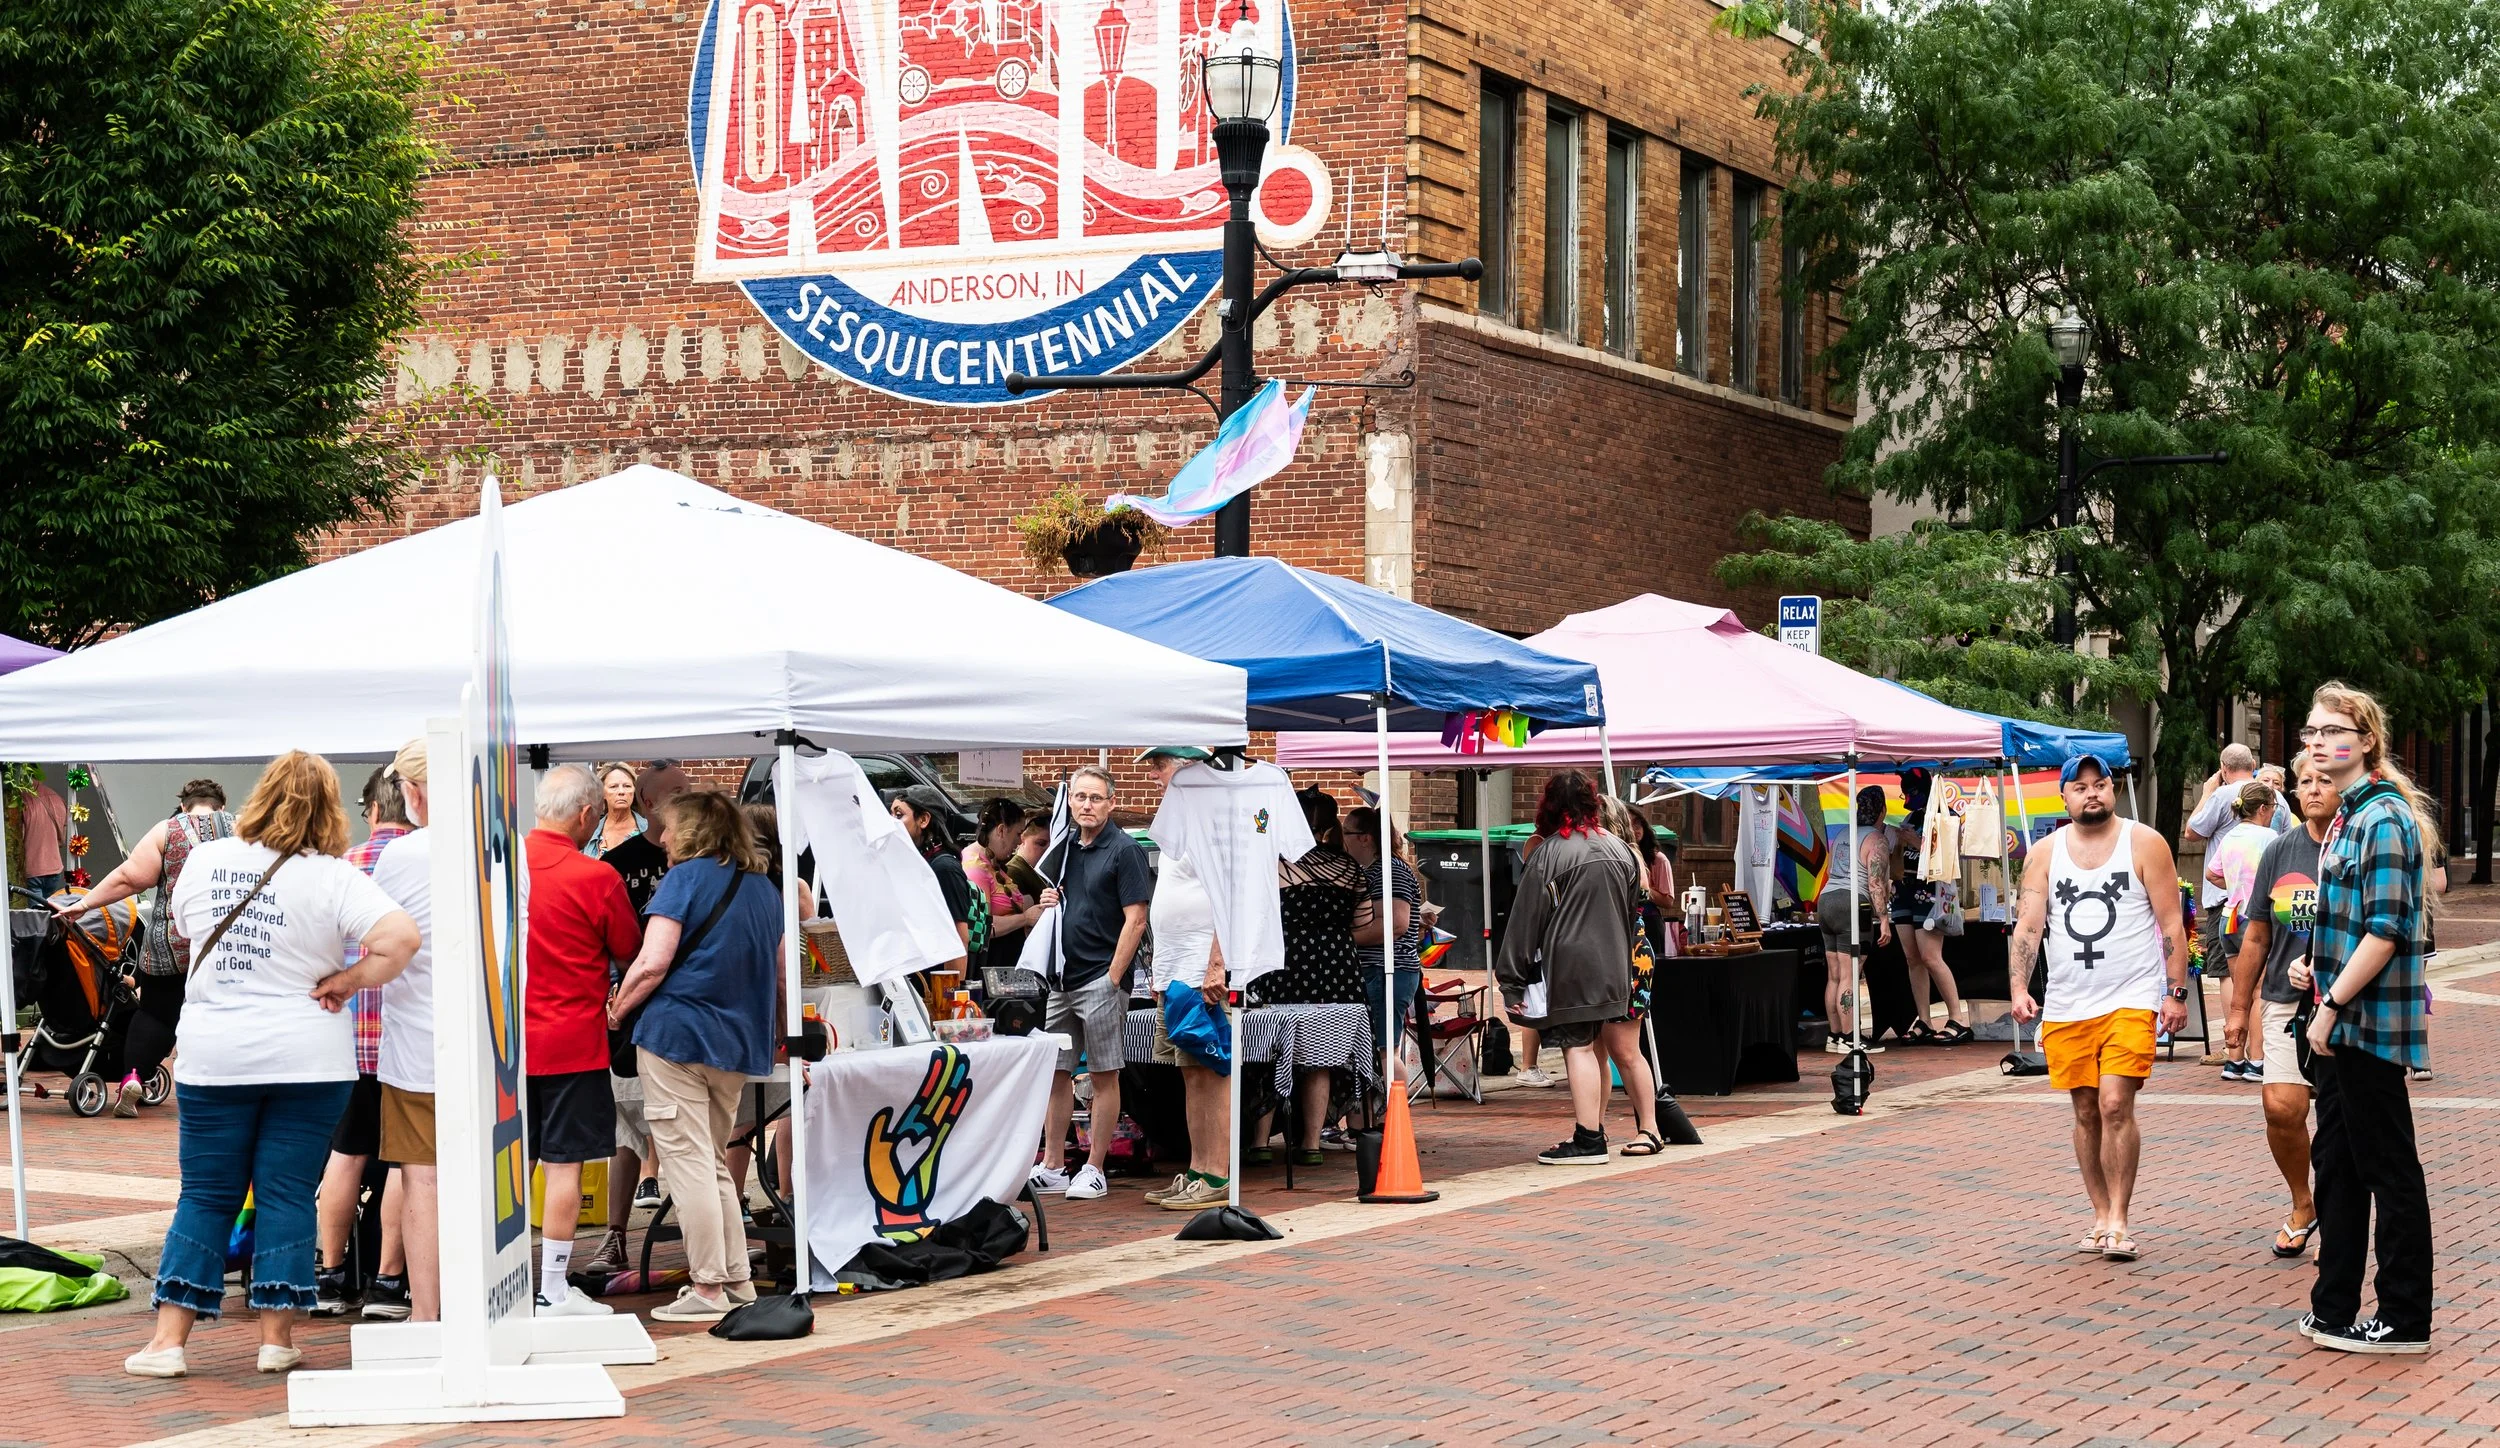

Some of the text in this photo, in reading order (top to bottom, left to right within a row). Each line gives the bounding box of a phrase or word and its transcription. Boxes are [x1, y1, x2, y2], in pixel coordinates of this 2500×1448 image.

[755, 11, 766, 175] PARAMOUNT
[887, 269, 1084, 306] ANDERSON, IN
[786, 257, 1198, 385] SESQUICENTENNIAL
[1783, 605, 1815, 620] RELAX
[1787, 630, 1811, 640] KEEP
[211, 868, 227, 882] All
[211, 887, 231, 900] are
[2292, 890, 2316, 901] FR
[212, 903, 235, 918] and
[2291, 903, 2318, 917] MO
[260, 926, 271, 942] in
[236, 940, 271, 960] image
[215, 956, 256, 972] of God.
